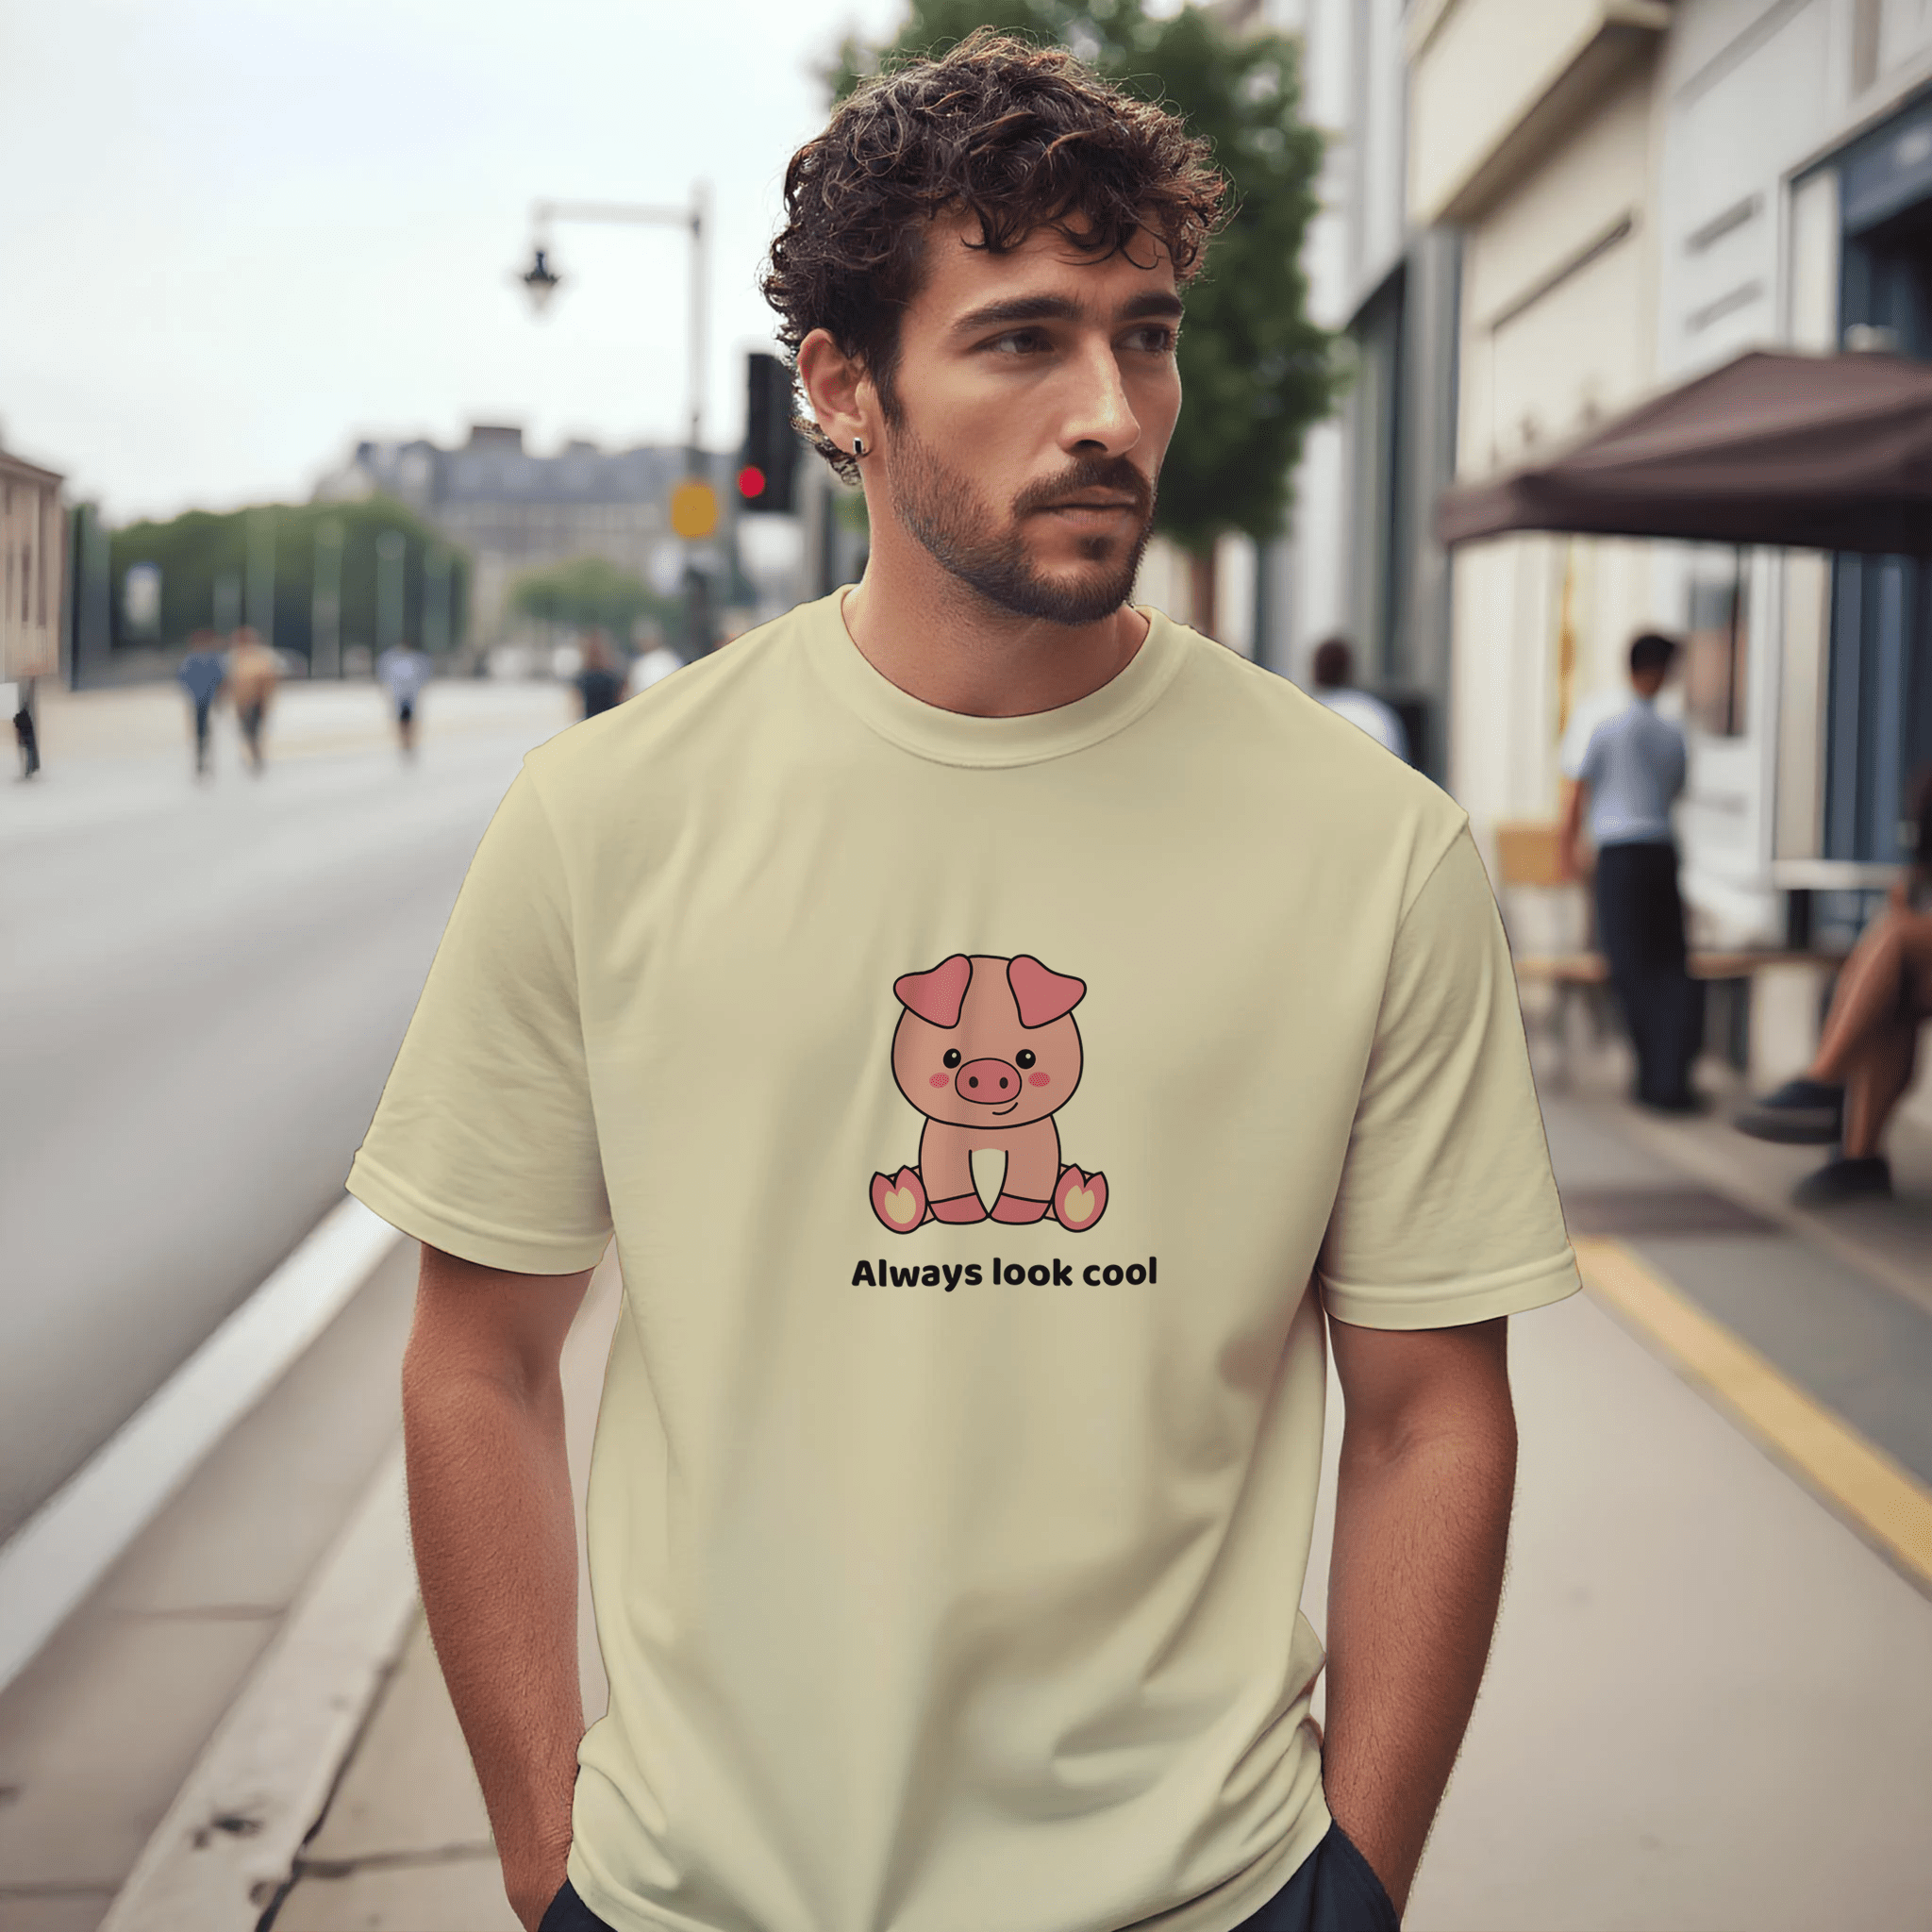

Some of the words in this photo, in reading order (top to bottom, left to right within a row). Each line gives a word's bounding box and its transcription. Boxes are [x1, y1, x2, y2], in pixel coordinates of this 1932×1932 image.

[851, 1258, 983, 1292] Always
[992, 1257, 1074, 1287] look
[1082, 1256, 1158, 1287] cool
